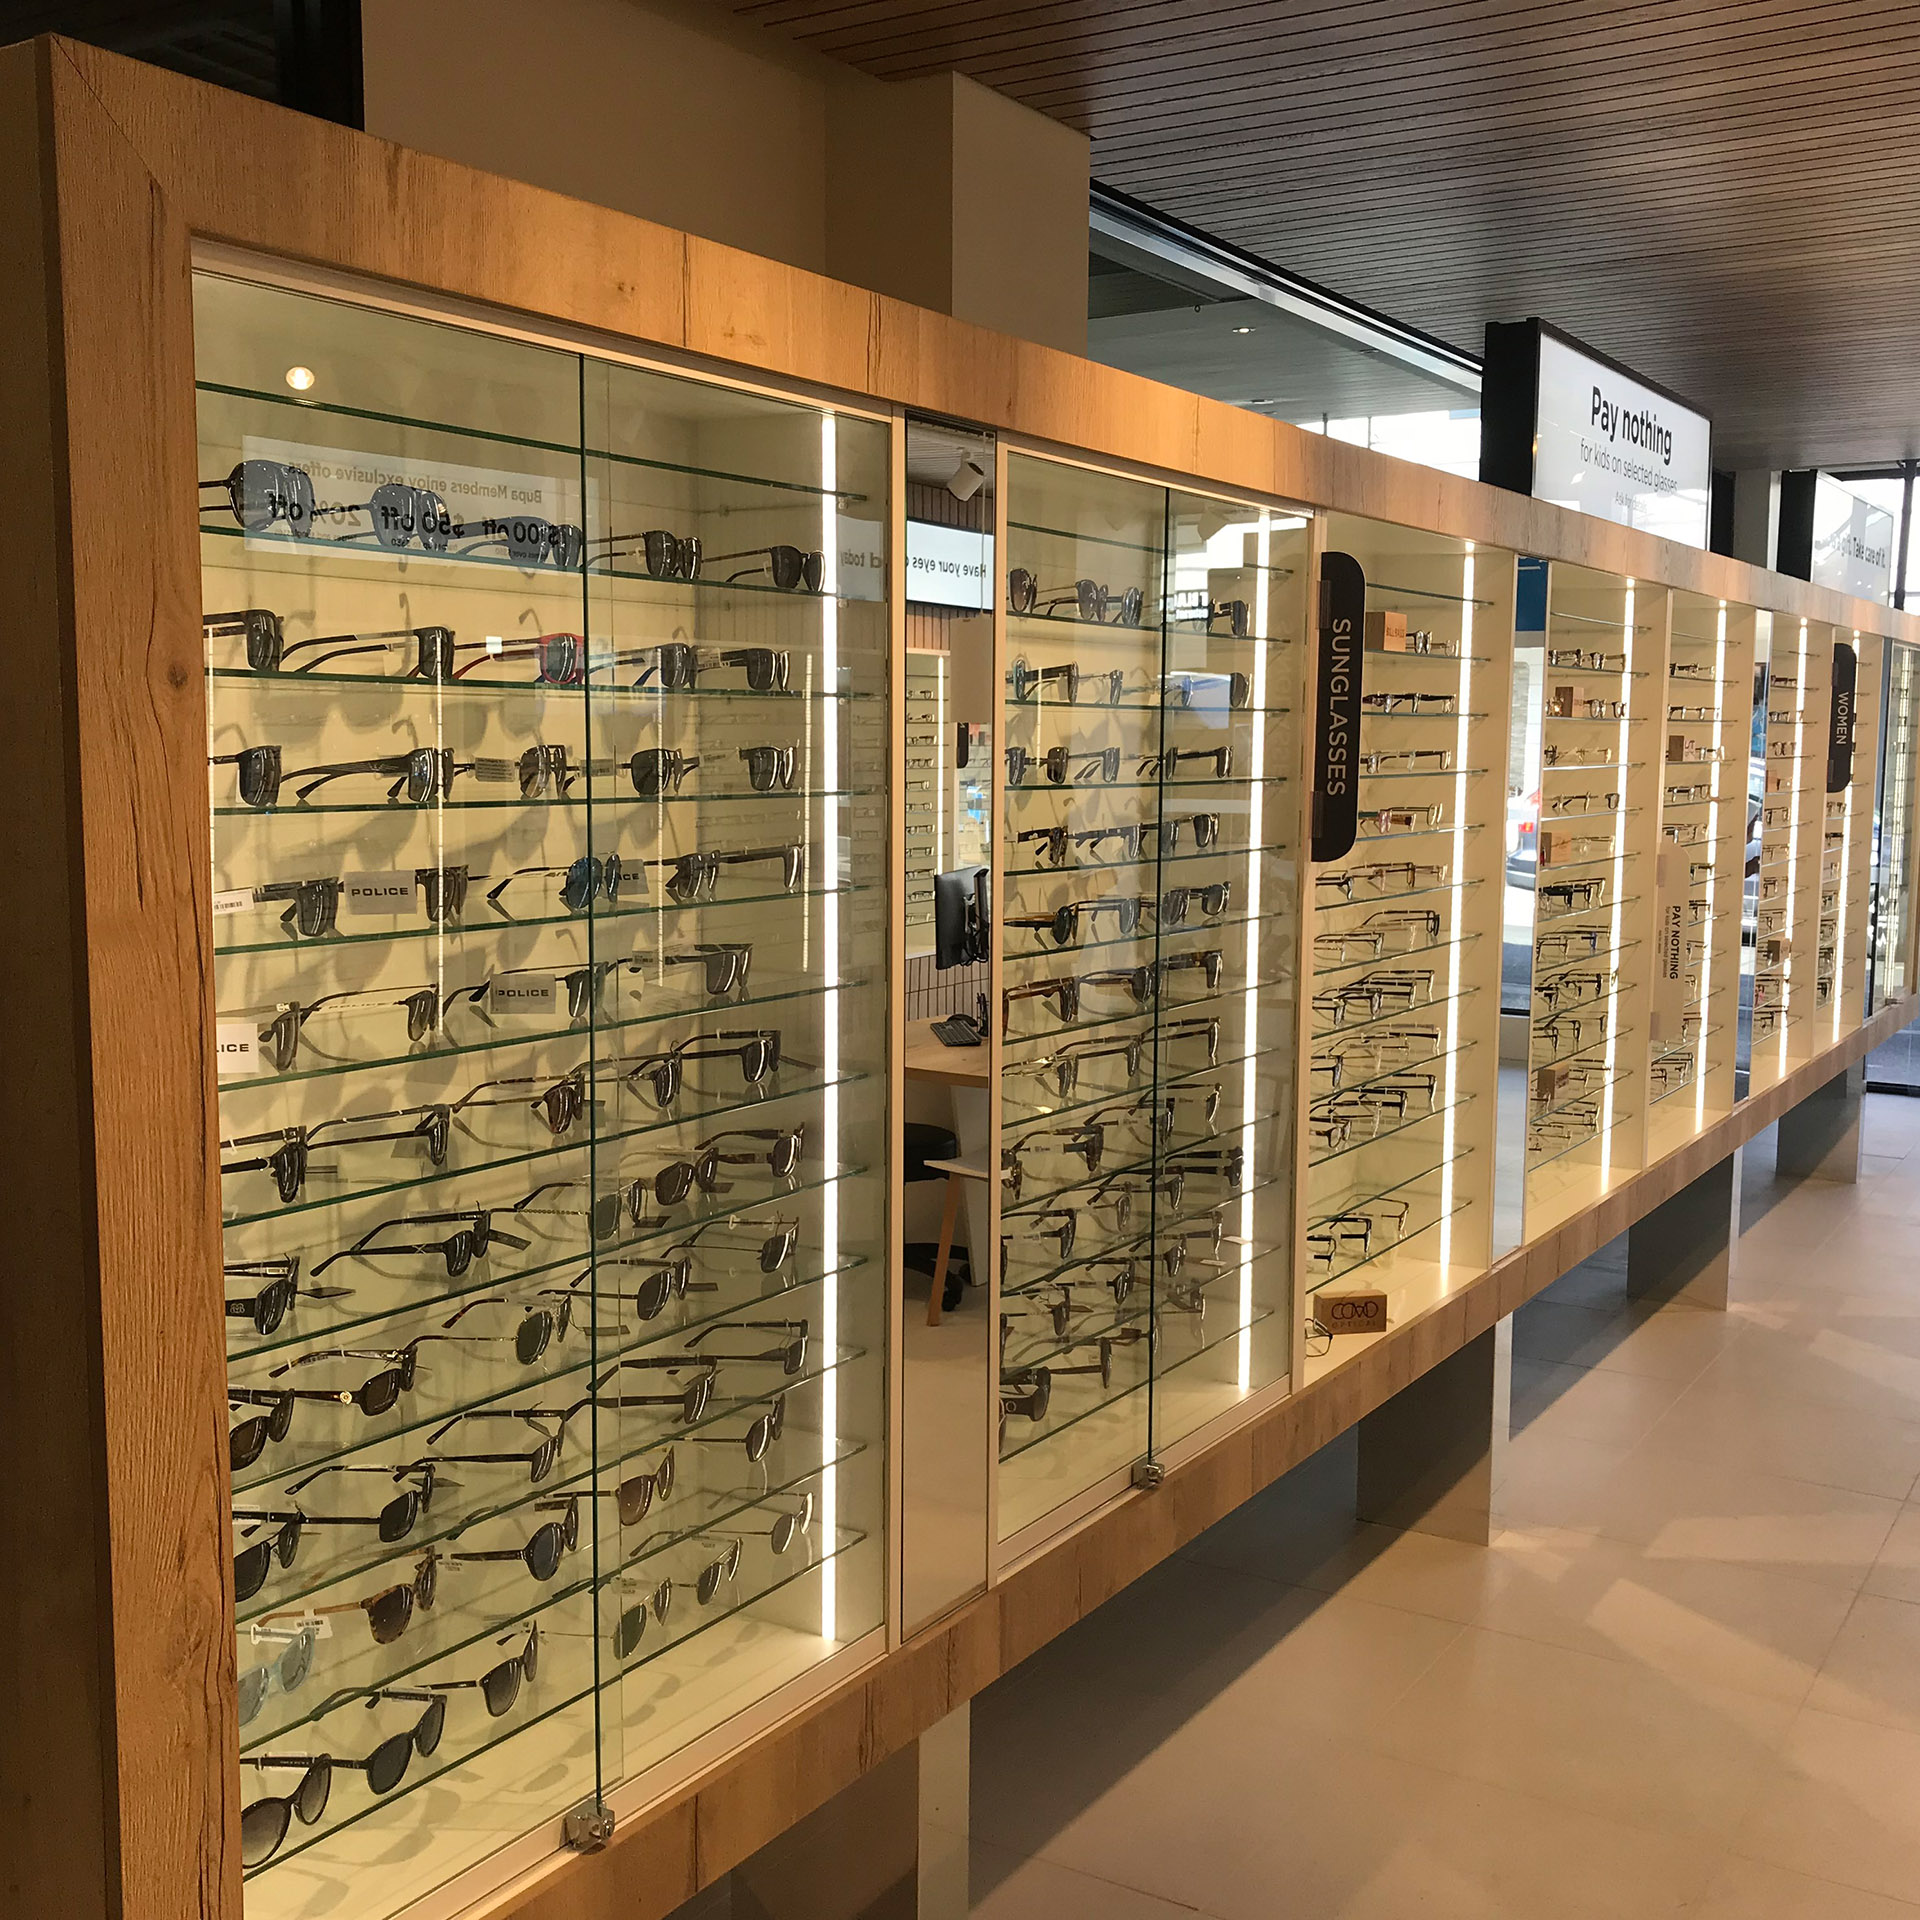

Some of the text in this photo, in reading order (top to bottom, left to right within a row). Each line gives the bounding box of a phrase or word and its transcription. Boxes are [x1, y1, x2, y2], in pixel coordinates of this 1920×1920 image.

[1591, 385, 1672, 466] Pay nothing
[1580, 438, 1678, 493] for kids on selected glasses
[1327, 618, 1351, 796] SUNGLASSES
[1836, 692, 1849, 745] WOMEN
[351, 885, 409, 898] POLICE
[1669, 905, 1681, 980] PAY NOTHING
[498, 989, 549, 997] POLICE
